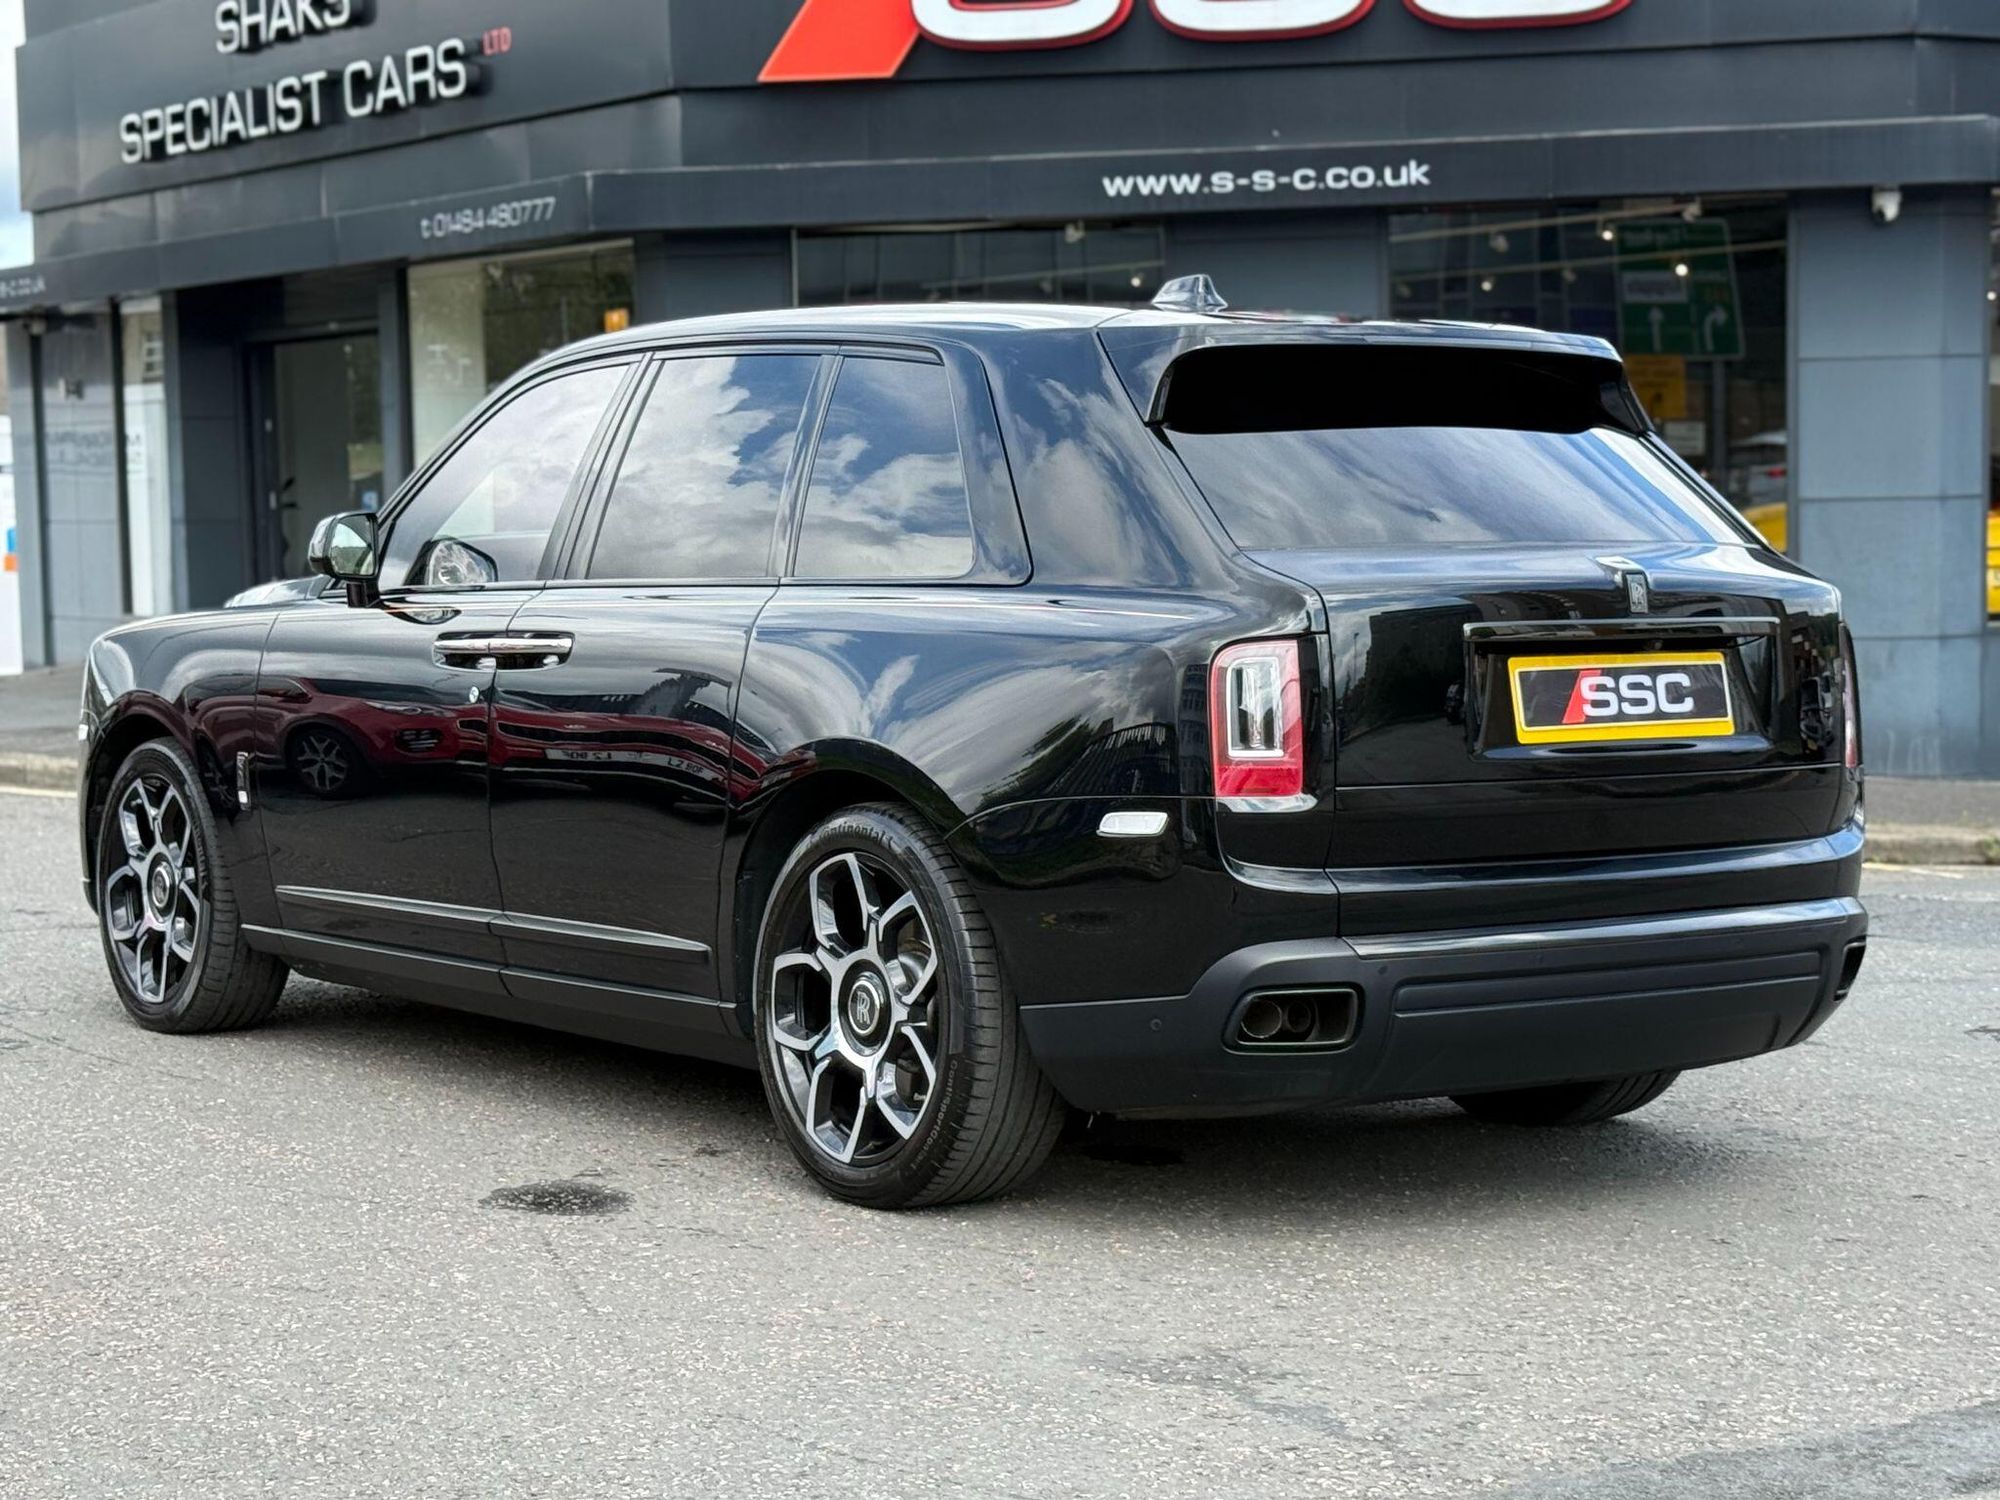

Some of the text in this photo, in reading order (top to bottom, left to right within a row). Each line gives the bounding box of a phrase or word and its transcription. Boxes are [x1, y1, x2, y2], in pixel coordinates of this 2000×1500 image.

[119, 26, 513, 165] SPECIALIST CARS LTD
[1101, 159, 1431, 198] www.s-s-c.co.uk
[1579, 672, 1695, 717] SSC
